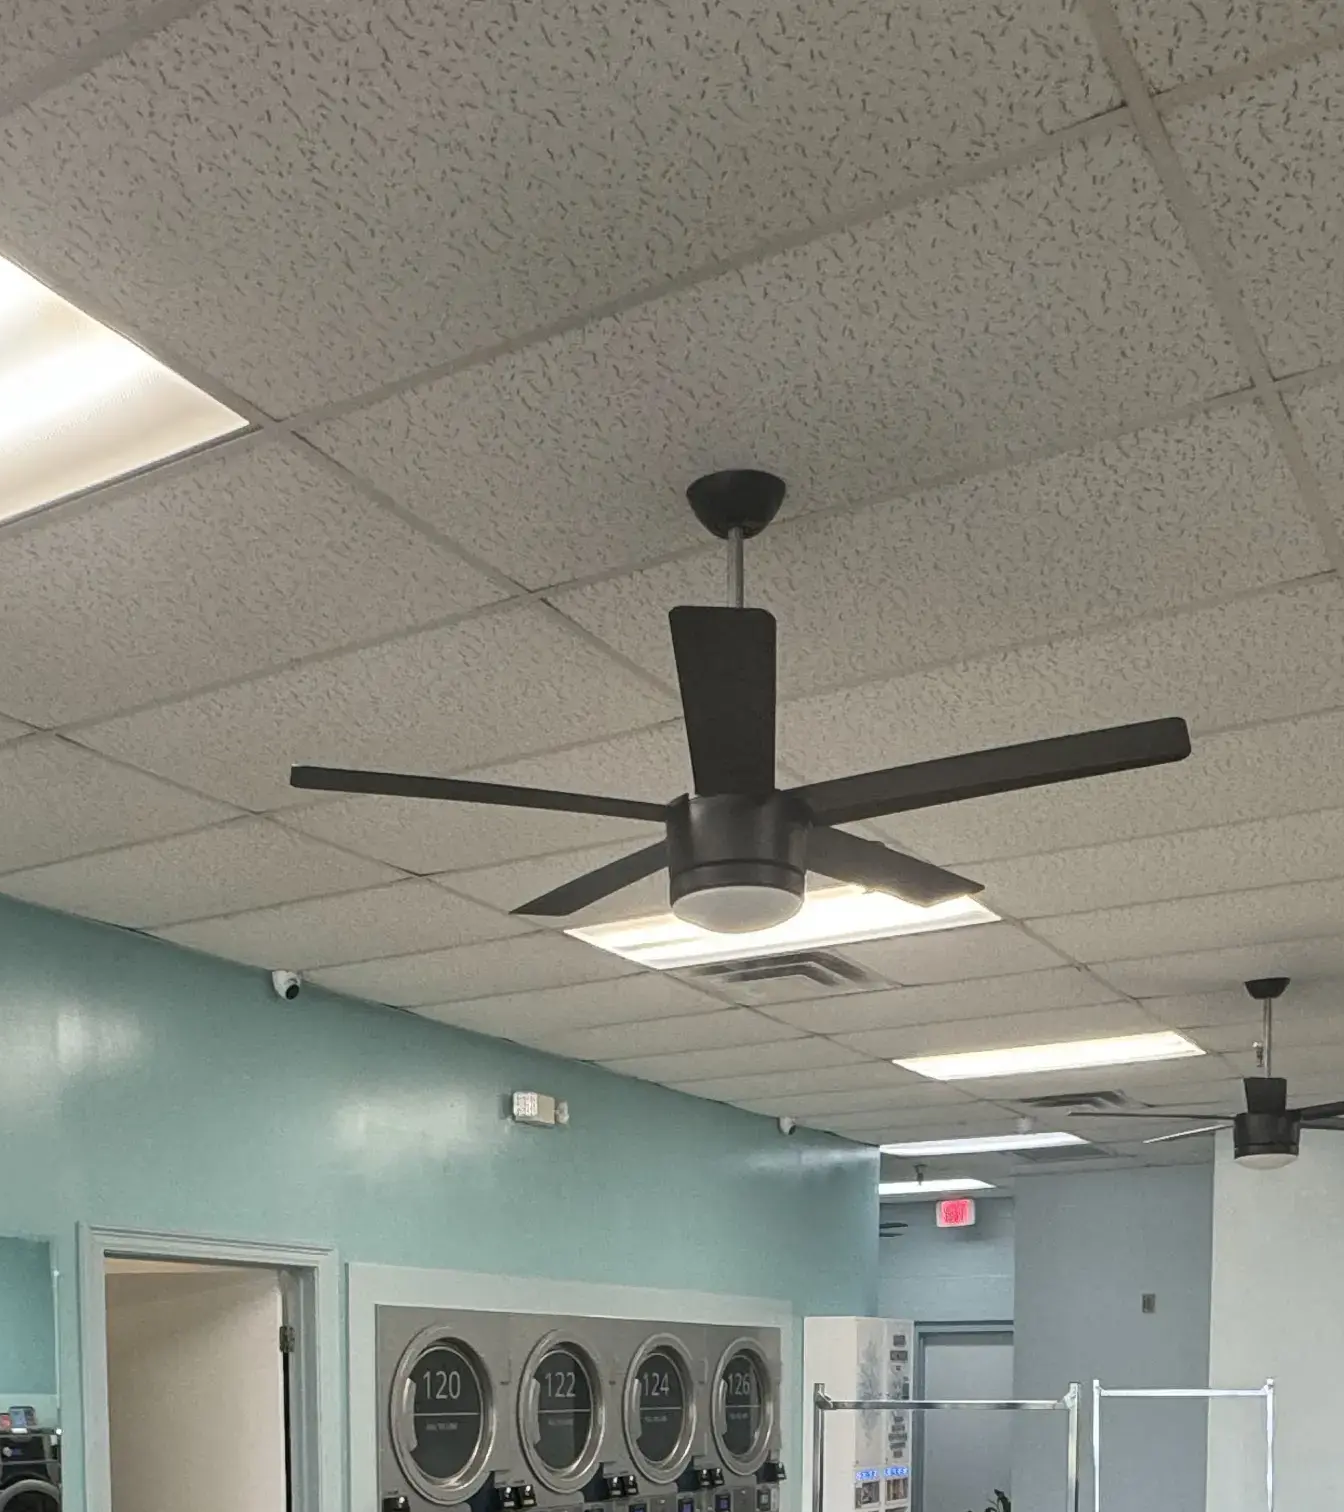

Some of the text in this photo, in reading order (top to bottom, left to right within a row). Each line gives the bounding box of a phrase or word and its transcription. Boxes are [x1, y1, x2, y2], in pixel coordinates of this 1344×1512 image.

[423, 1370, 461, 1400] 120
[545, 1371, 576, 1398] 122
[642, 1372, 670, 1397] 124
[727, 1372, 751, 1396] 126
